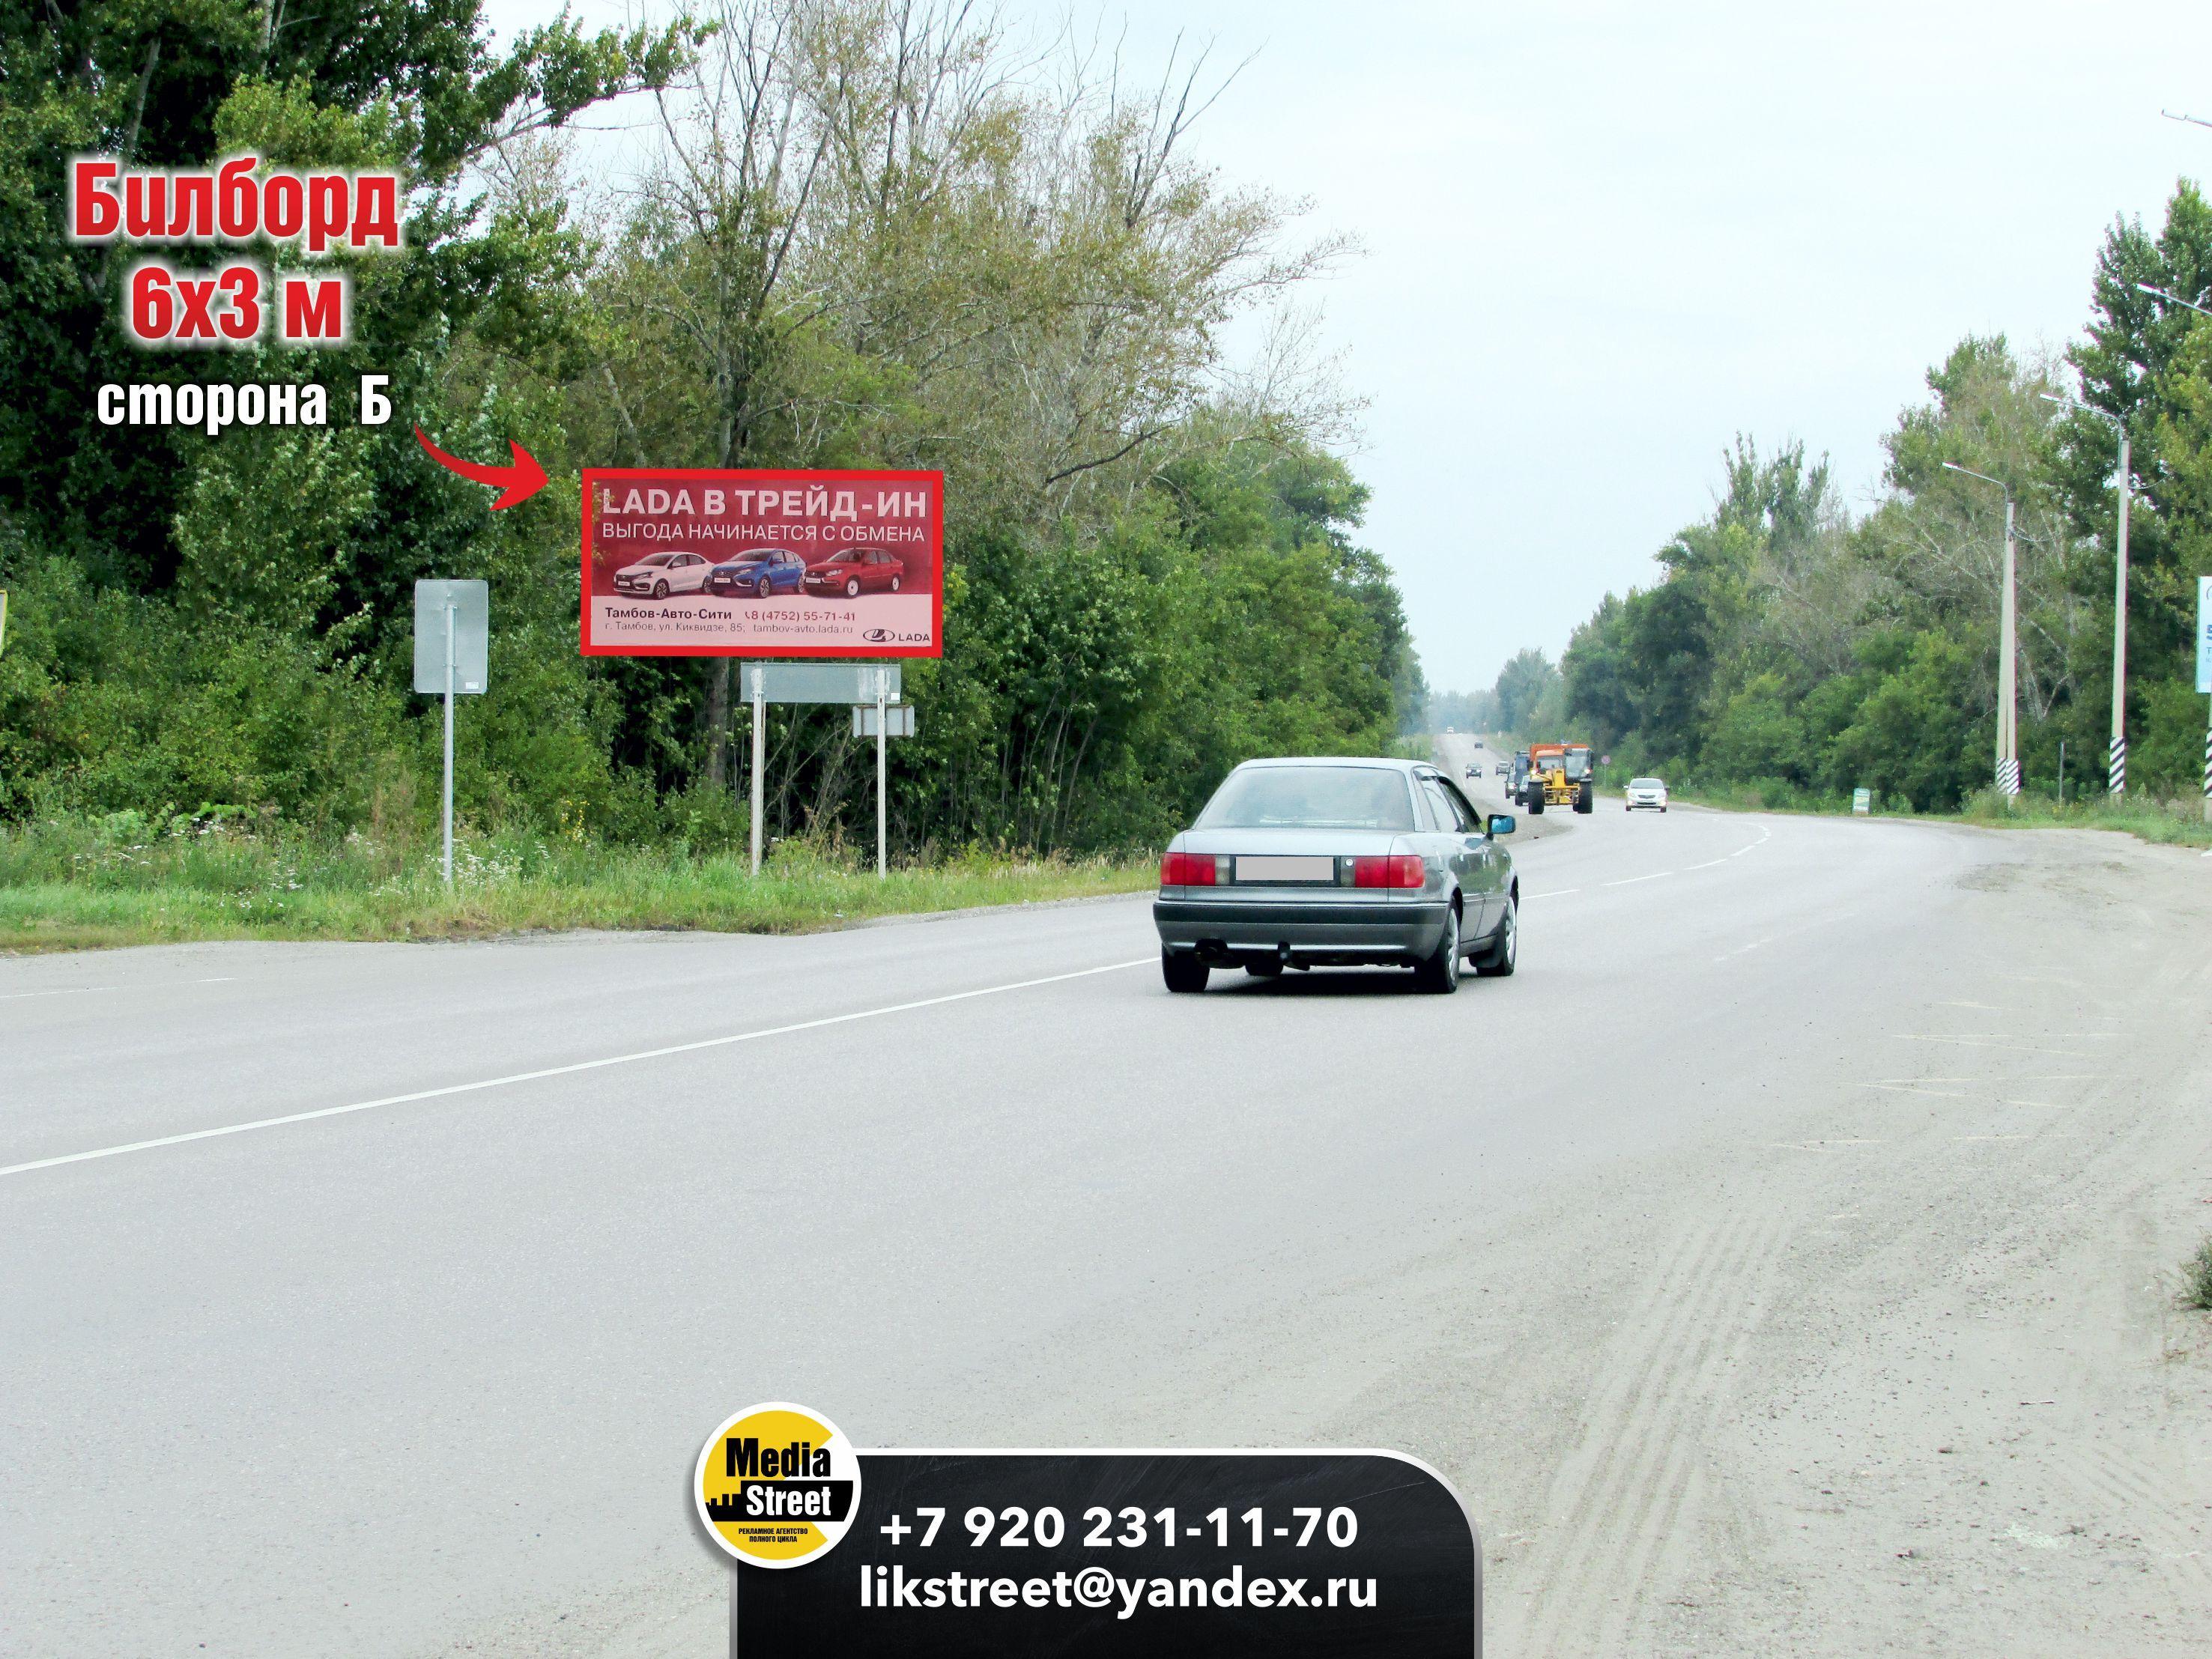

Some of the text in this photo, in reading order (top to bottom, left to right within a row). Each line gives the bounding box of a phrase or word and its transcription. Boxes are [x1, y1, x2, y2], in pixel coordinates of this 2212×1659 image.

[603, 485, 926, 522] LADA В ТРЕЙД-ИН
[603, 523, 925, 542] ВЫГОДА НАЧИНАЕТСЯ С ОБМЕНА
[604, 607, 732, 619] Тамбов-Авто-Сити
[751, 610, 855, 622] 8 (4752) 55-71-41
[616, 621, 656, 631] Тамбов,
[676, 622, 727, 633] Киквидзе,
[753, 624, 853, 634] tambov-avto.lada.ru
[898, 633, 931, 642] LADA
